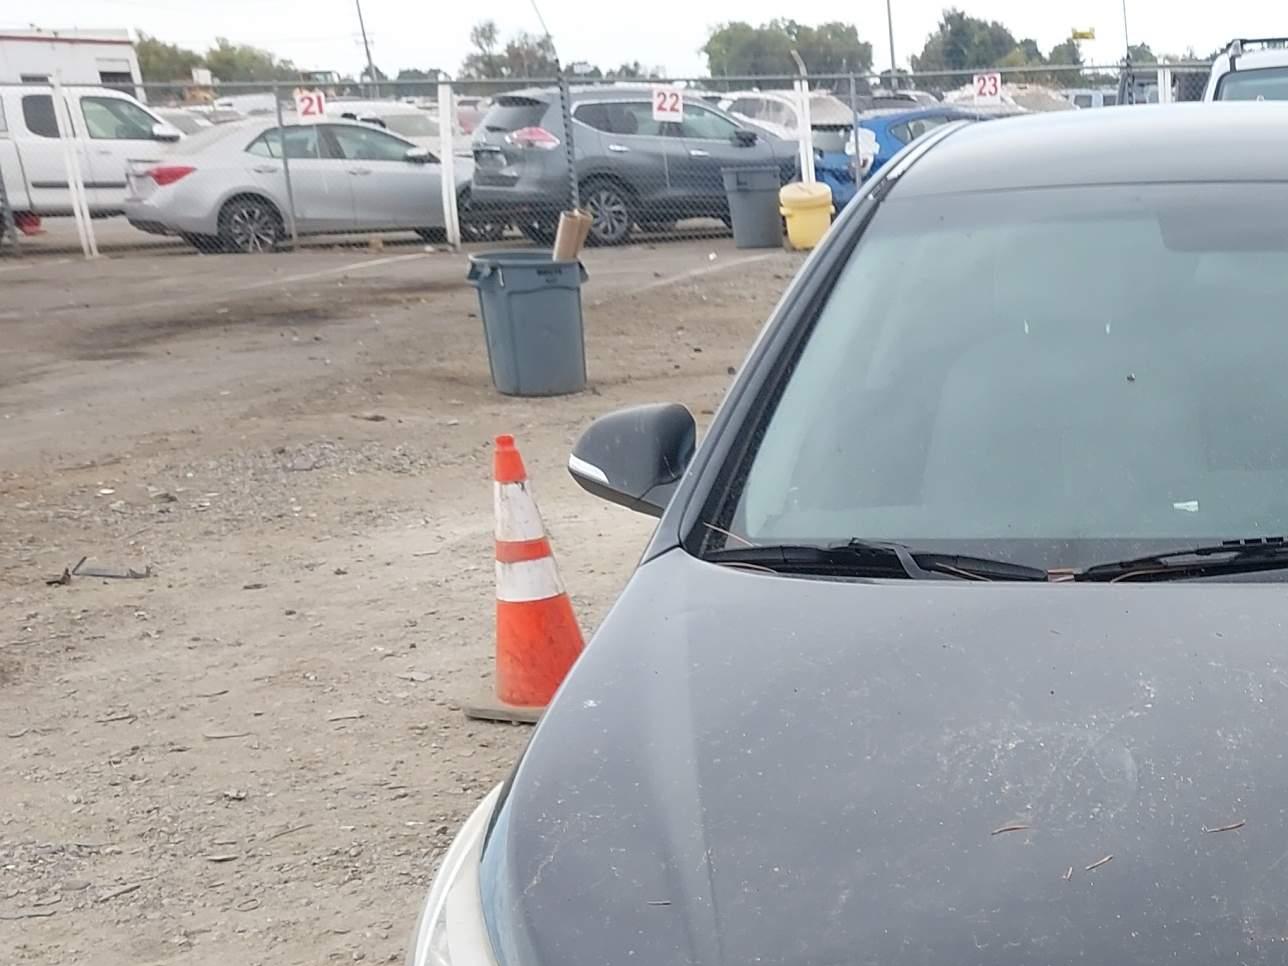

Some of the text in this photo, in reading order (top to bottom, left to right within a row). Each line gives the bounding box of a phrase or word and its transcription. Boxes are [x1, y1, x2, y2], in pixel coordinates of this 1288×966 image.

[977, 75, 998, 97] 23
[300, 95, 324, 116] 21
[656, 91, 680, 112] 22
